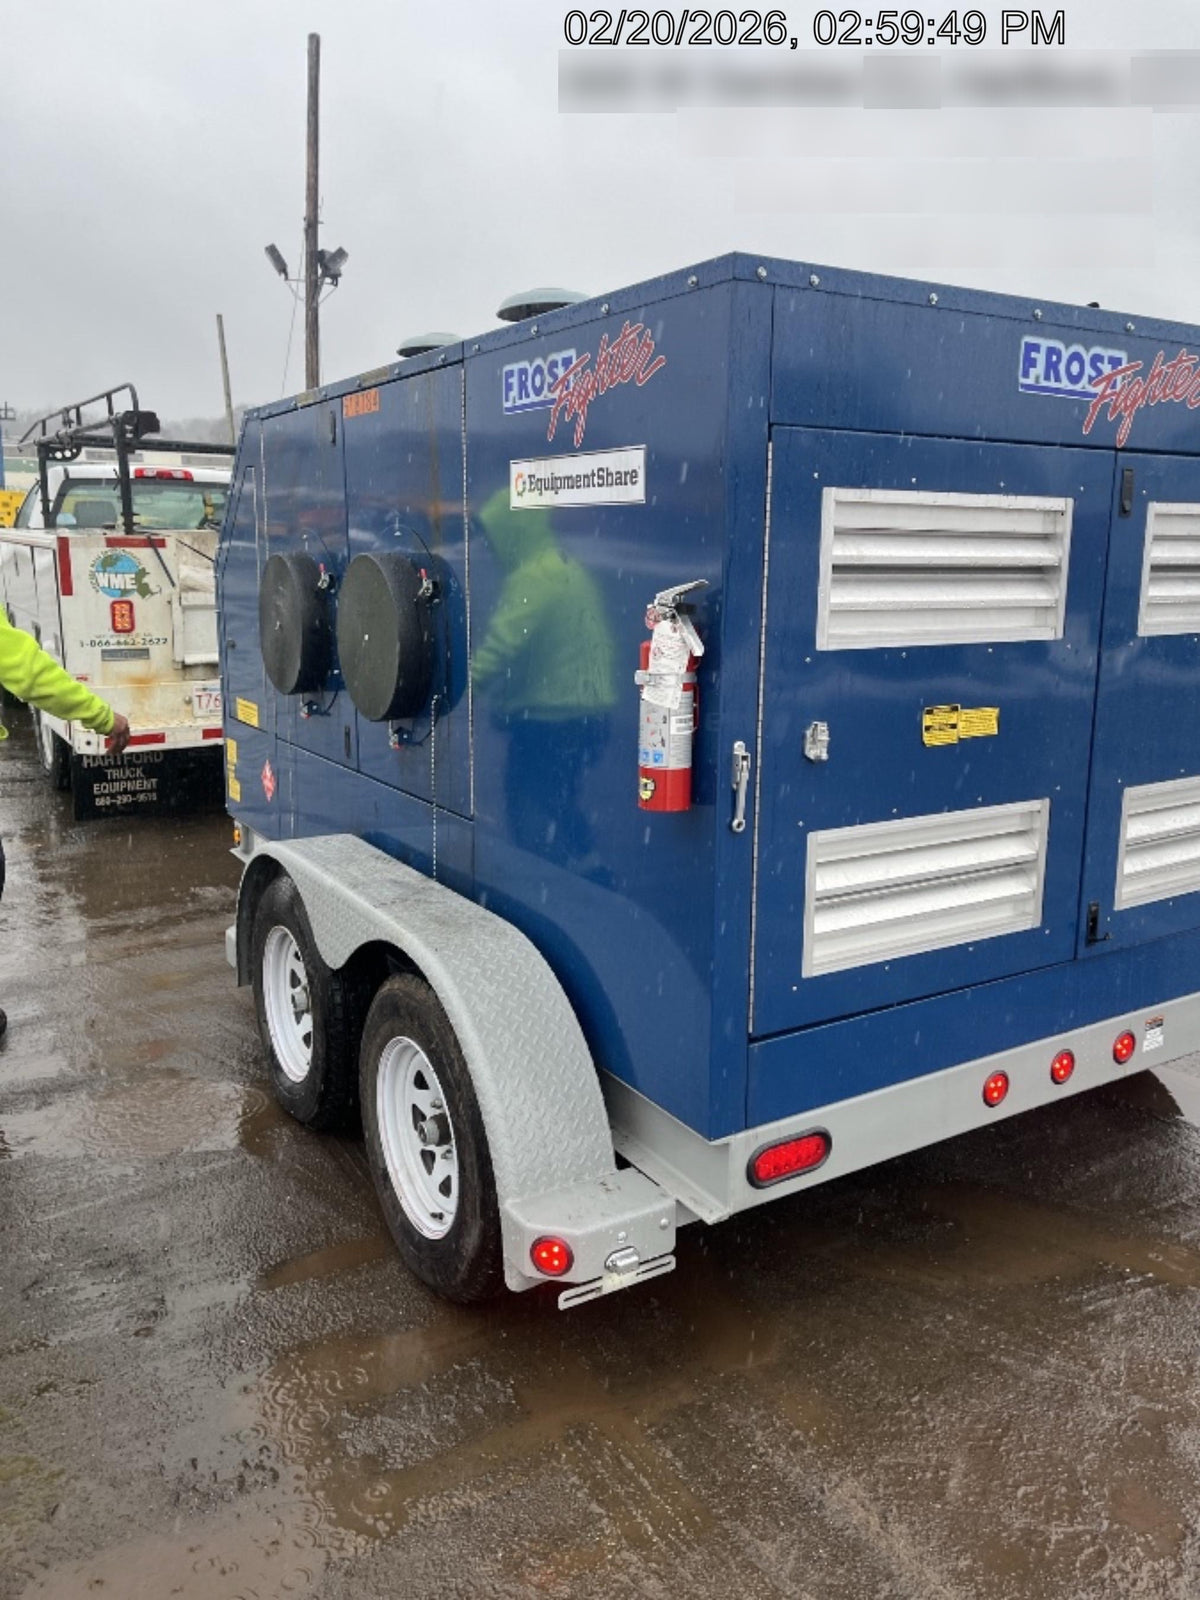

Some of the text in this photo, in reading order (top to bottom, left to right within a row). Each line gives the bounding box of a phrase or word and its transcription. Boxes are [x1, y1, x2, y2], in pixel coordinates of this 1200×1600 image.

[1021, 341, 1123, 390] FROST
[504, 320, 666, 448] FROST Fighter
[527, 467, 639, 496] EquipmentShare
[95, 572, 138, 590] WME
[82, 752, 164, 768] HARTFORD
[104, 767, 144, 780] TRUCK
[93, 778, 158, 795] EQUIPMENT
